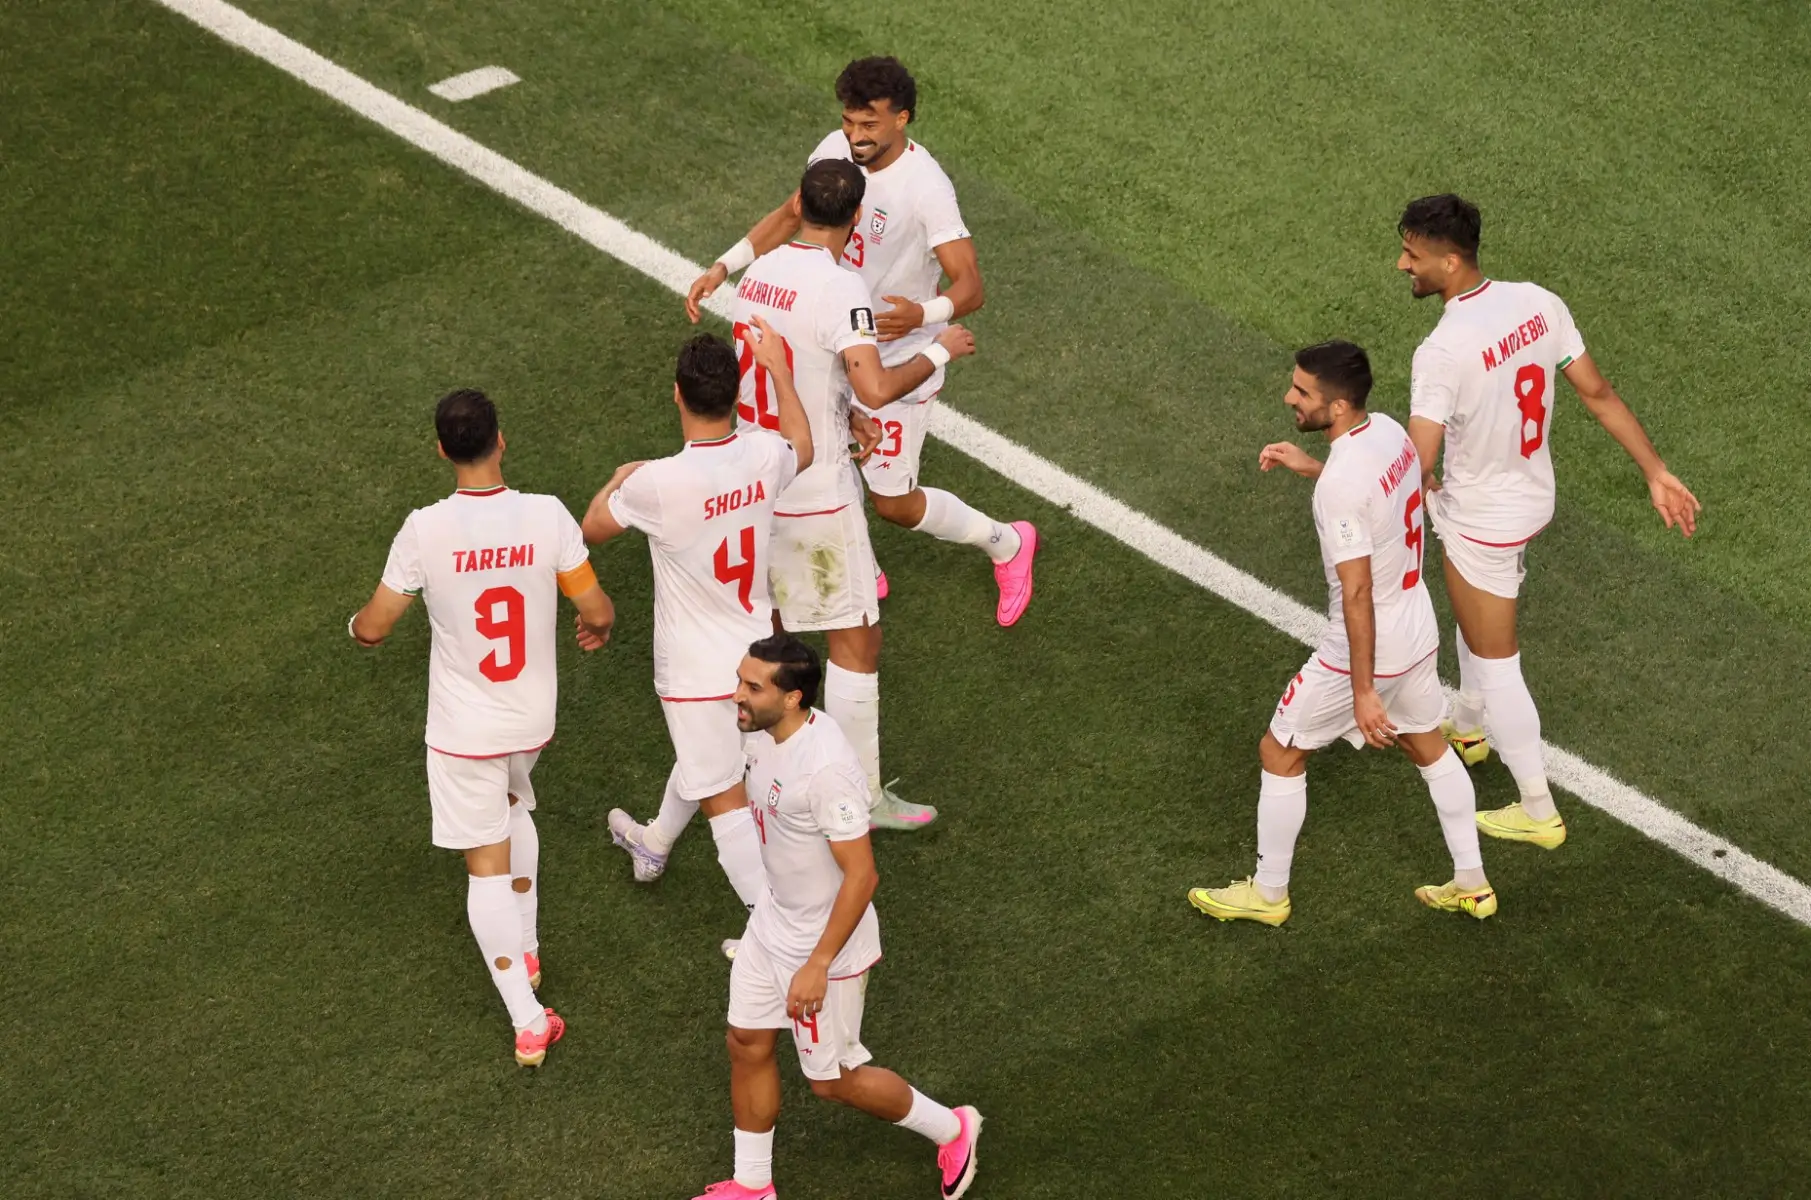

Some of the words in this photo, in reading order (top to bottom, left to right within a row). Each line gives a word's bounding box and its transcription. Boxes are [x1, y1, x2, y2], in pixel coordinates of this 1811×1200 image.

[842, 231, 865, 269] 3
[736, 276, 798, 312] HAHRIYAR
[1514, 363, 1546, 460] 8
[703, 479, 766, 521] SHOJA
[452, 543, 534, 573] TAREMI
[1402, 487, 1422, 591] 5
[712, 525, 755, 614] 4
[474, 585, 526, 683] 9
[1281, 672, 1304, 706] 5
